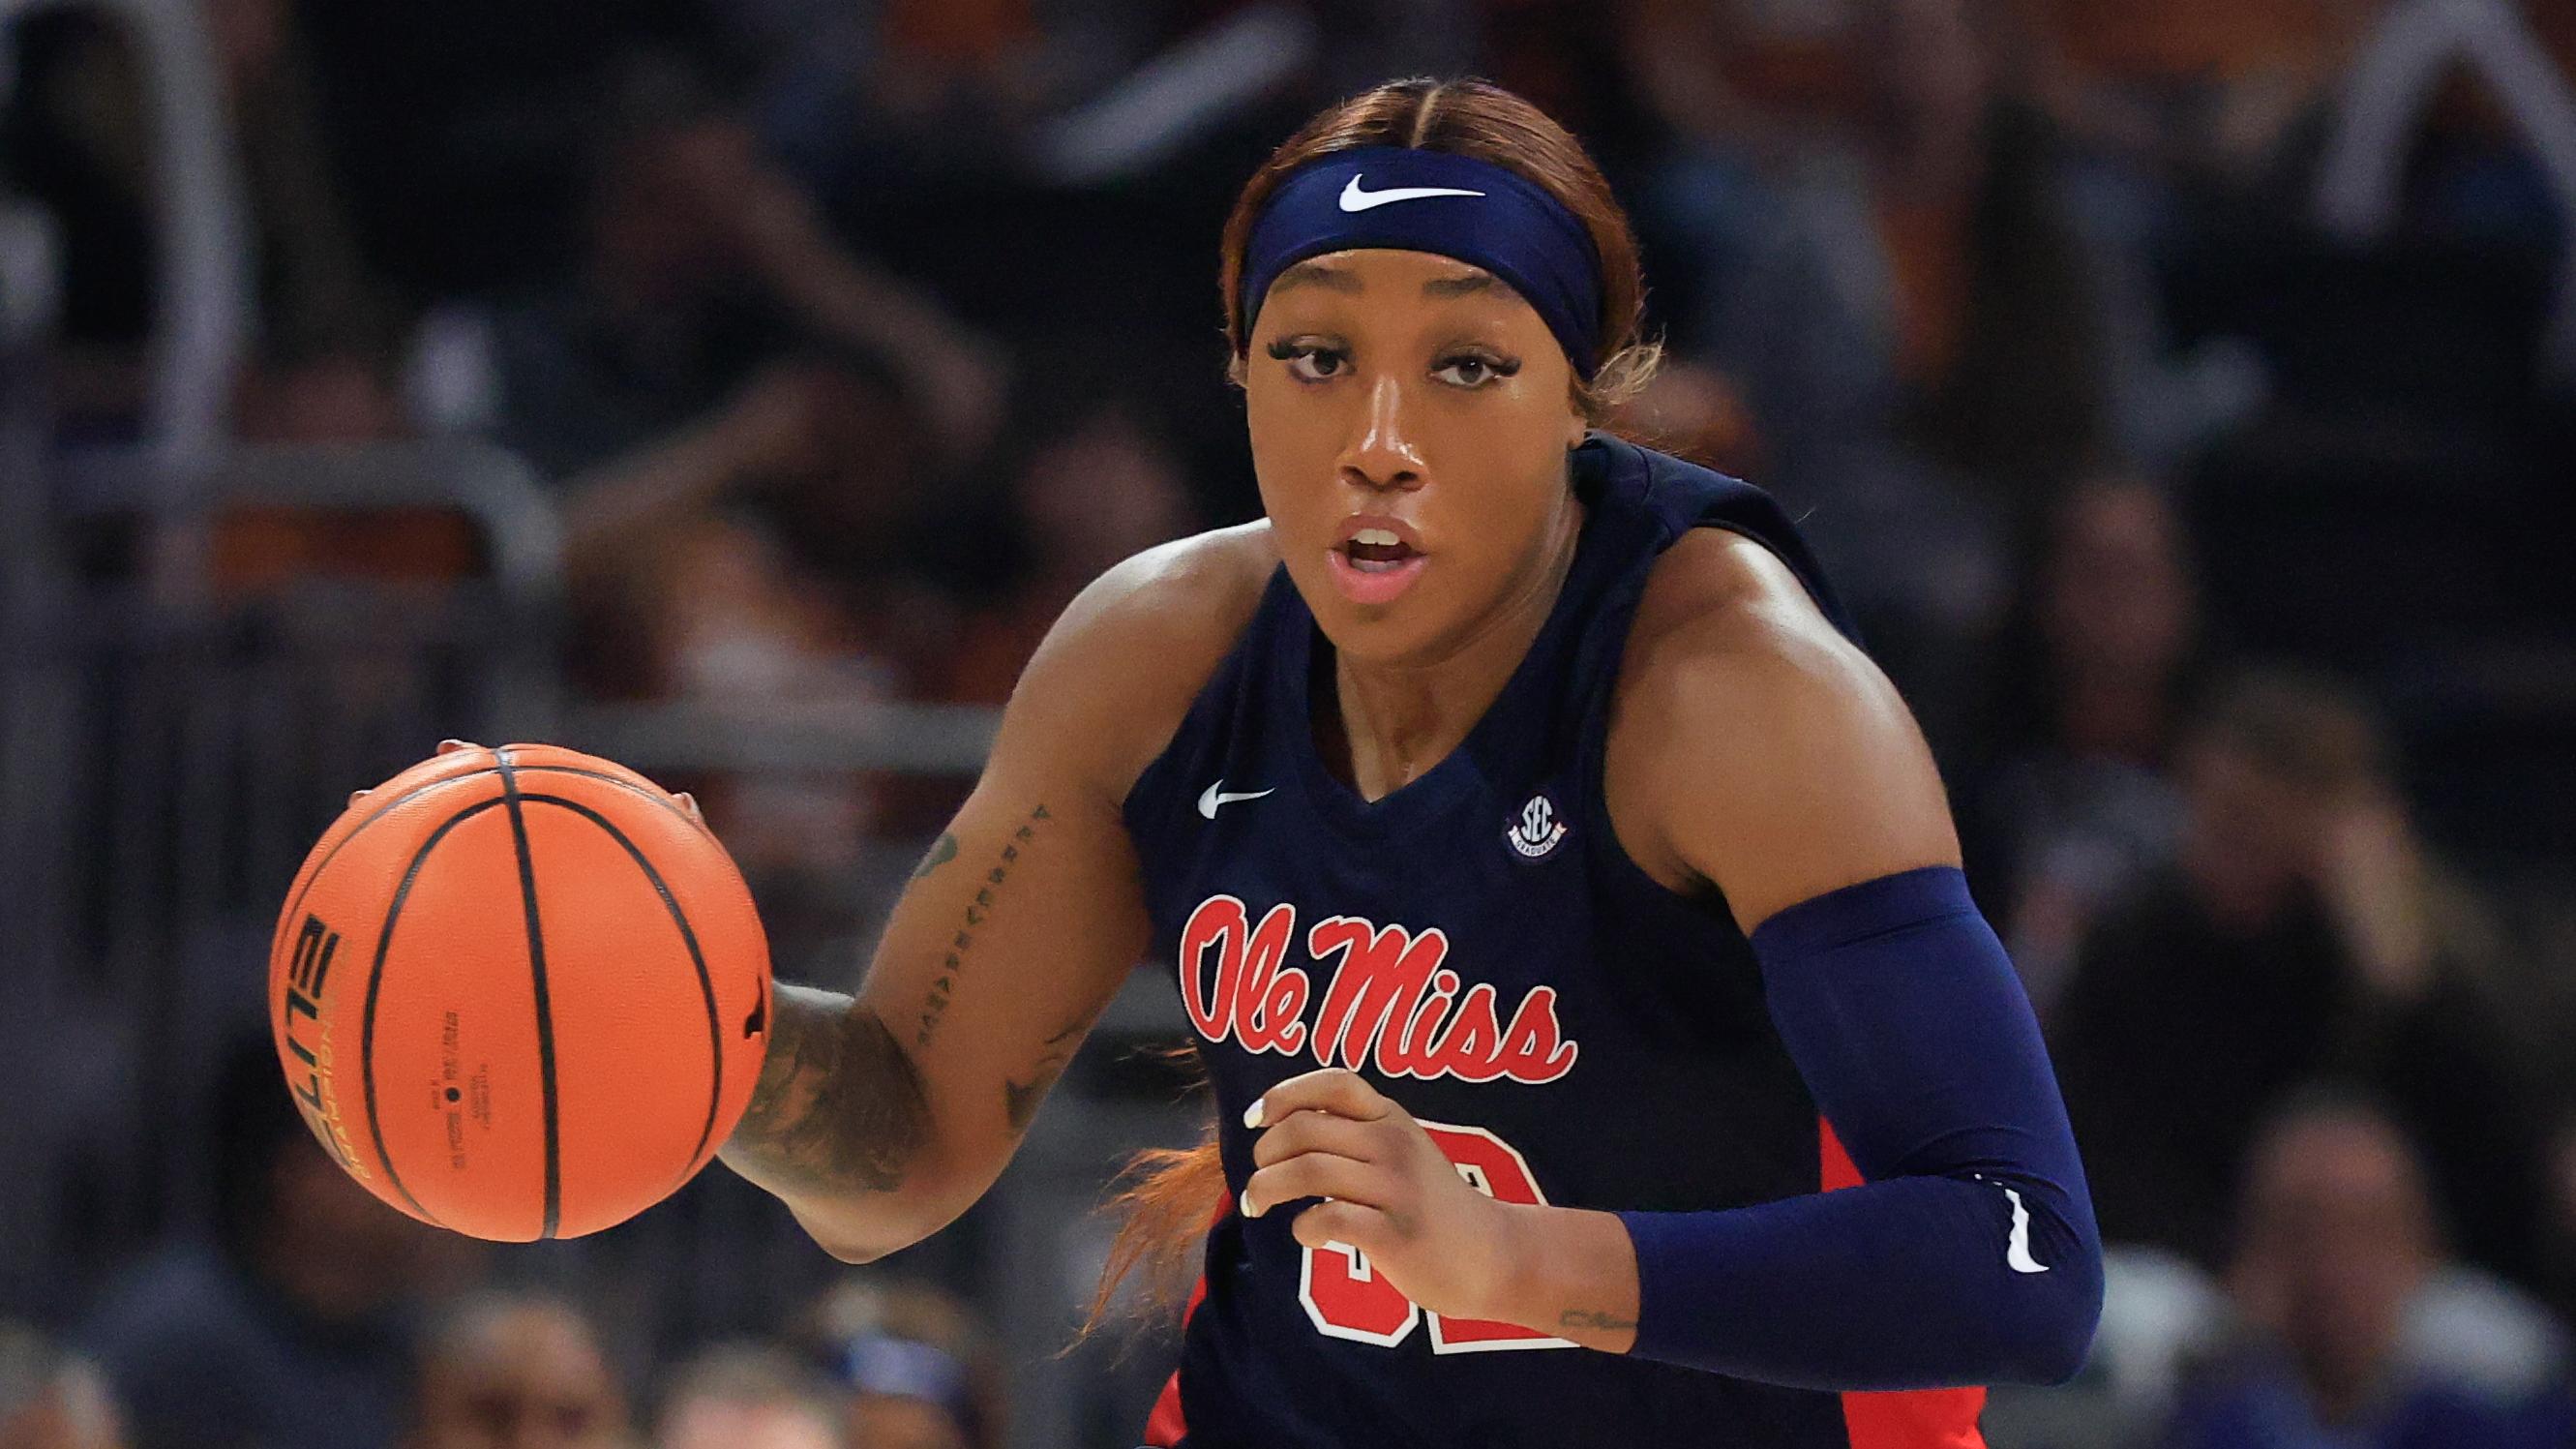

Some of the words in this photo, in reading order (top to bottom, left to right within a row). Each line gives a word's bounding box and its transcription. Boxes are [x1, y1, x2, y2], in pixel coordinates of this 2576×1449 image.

[1520, 796, 1553, 842] SEC
[1180, 894, 1309, 1056] Ole
[1308, 915, 1578, 1084] Miss
